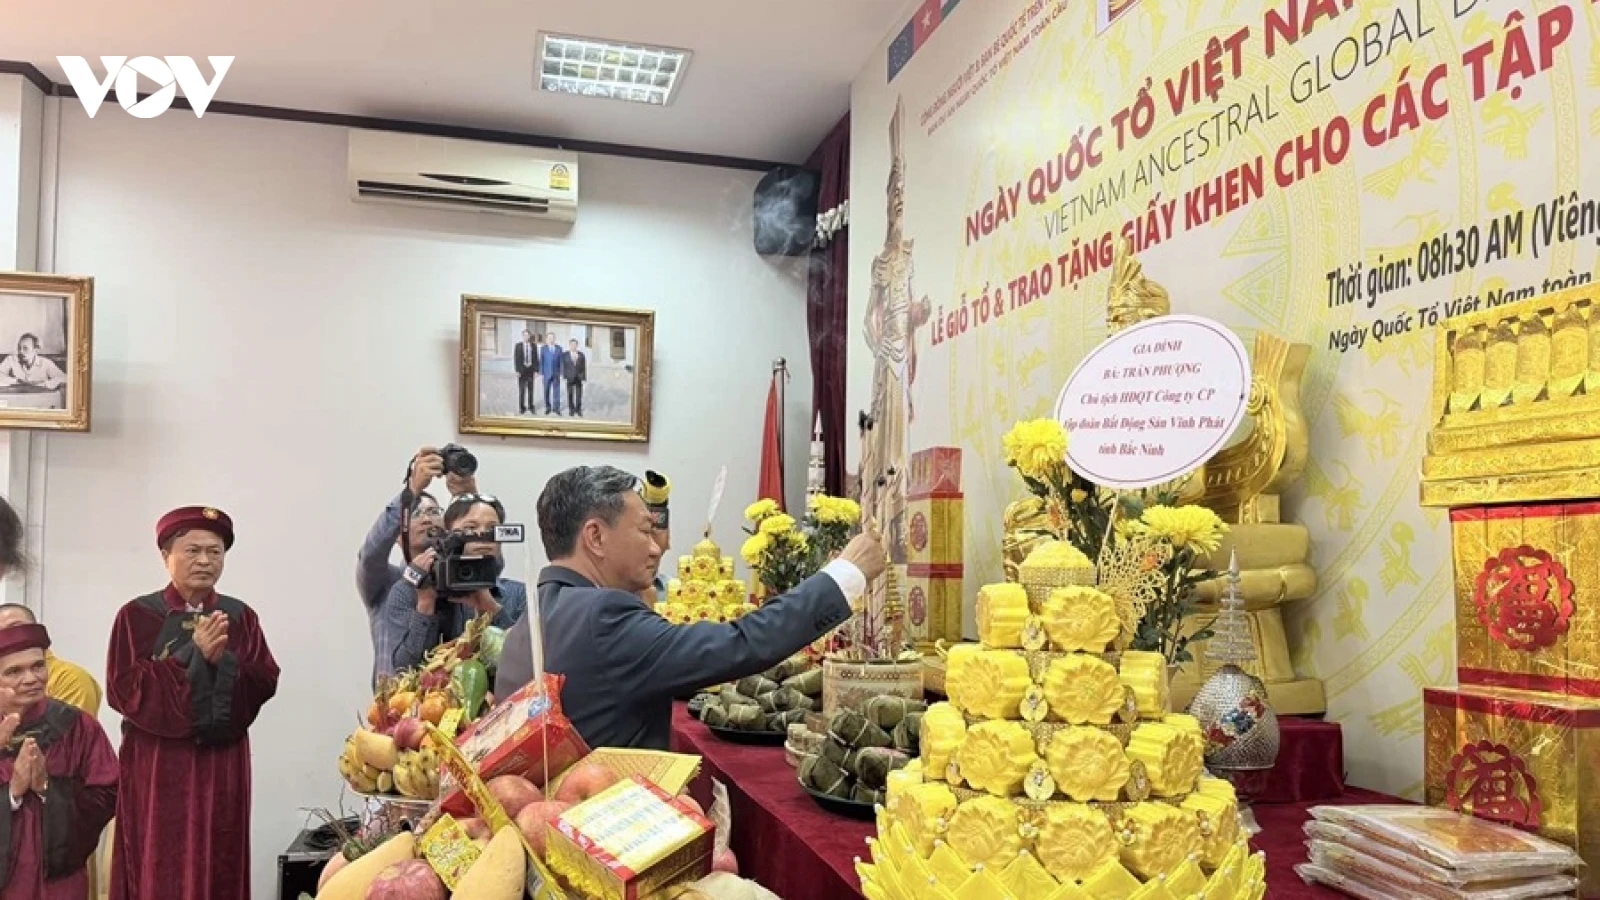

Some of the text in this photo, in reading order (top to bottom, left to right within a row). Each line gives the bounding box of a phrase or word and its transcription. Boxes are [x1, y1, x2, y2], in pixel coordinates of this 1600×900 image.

[965, 181, 1022, 247] NGÀY
[1027, 125, 1103, 205] QUỐC
[1111, 76, 1155, 150] TỔ
[1164, 26, 1250, 116] VIỆT
[1044, 0, 1435, 240] VIETNAM ANCESTRAL GLOBAL
[931, 5, 1574, 346] LỄ GIỖ TỔ & TRAO TẶNG GIẤY KHEN CHO CÁC TẬP
[1326, 261, 1363, 308] Thời
[1366, 253, 1412, 308] gian:
[1418, 225, 1480, 282] 08h30
[1485, 210, 1524, 263] AM
[1329, 269, 1591, 352] Ngày Quốc Tổ Việt Nam toàn
[1133, 344, 1150, 354] GIA
[1152, 362, 1201, 377] PHƯỢNG
[1120, 390, 1153, 405] HĐQT
[1155, 389, 1182, 405] Công
[1184, 391, 1194, 404] ty
[1197, 388, 1216, 401] CP
[1199, 416, 1225, 428] Phát
[1140, 444, 1164, 456] Ninh
